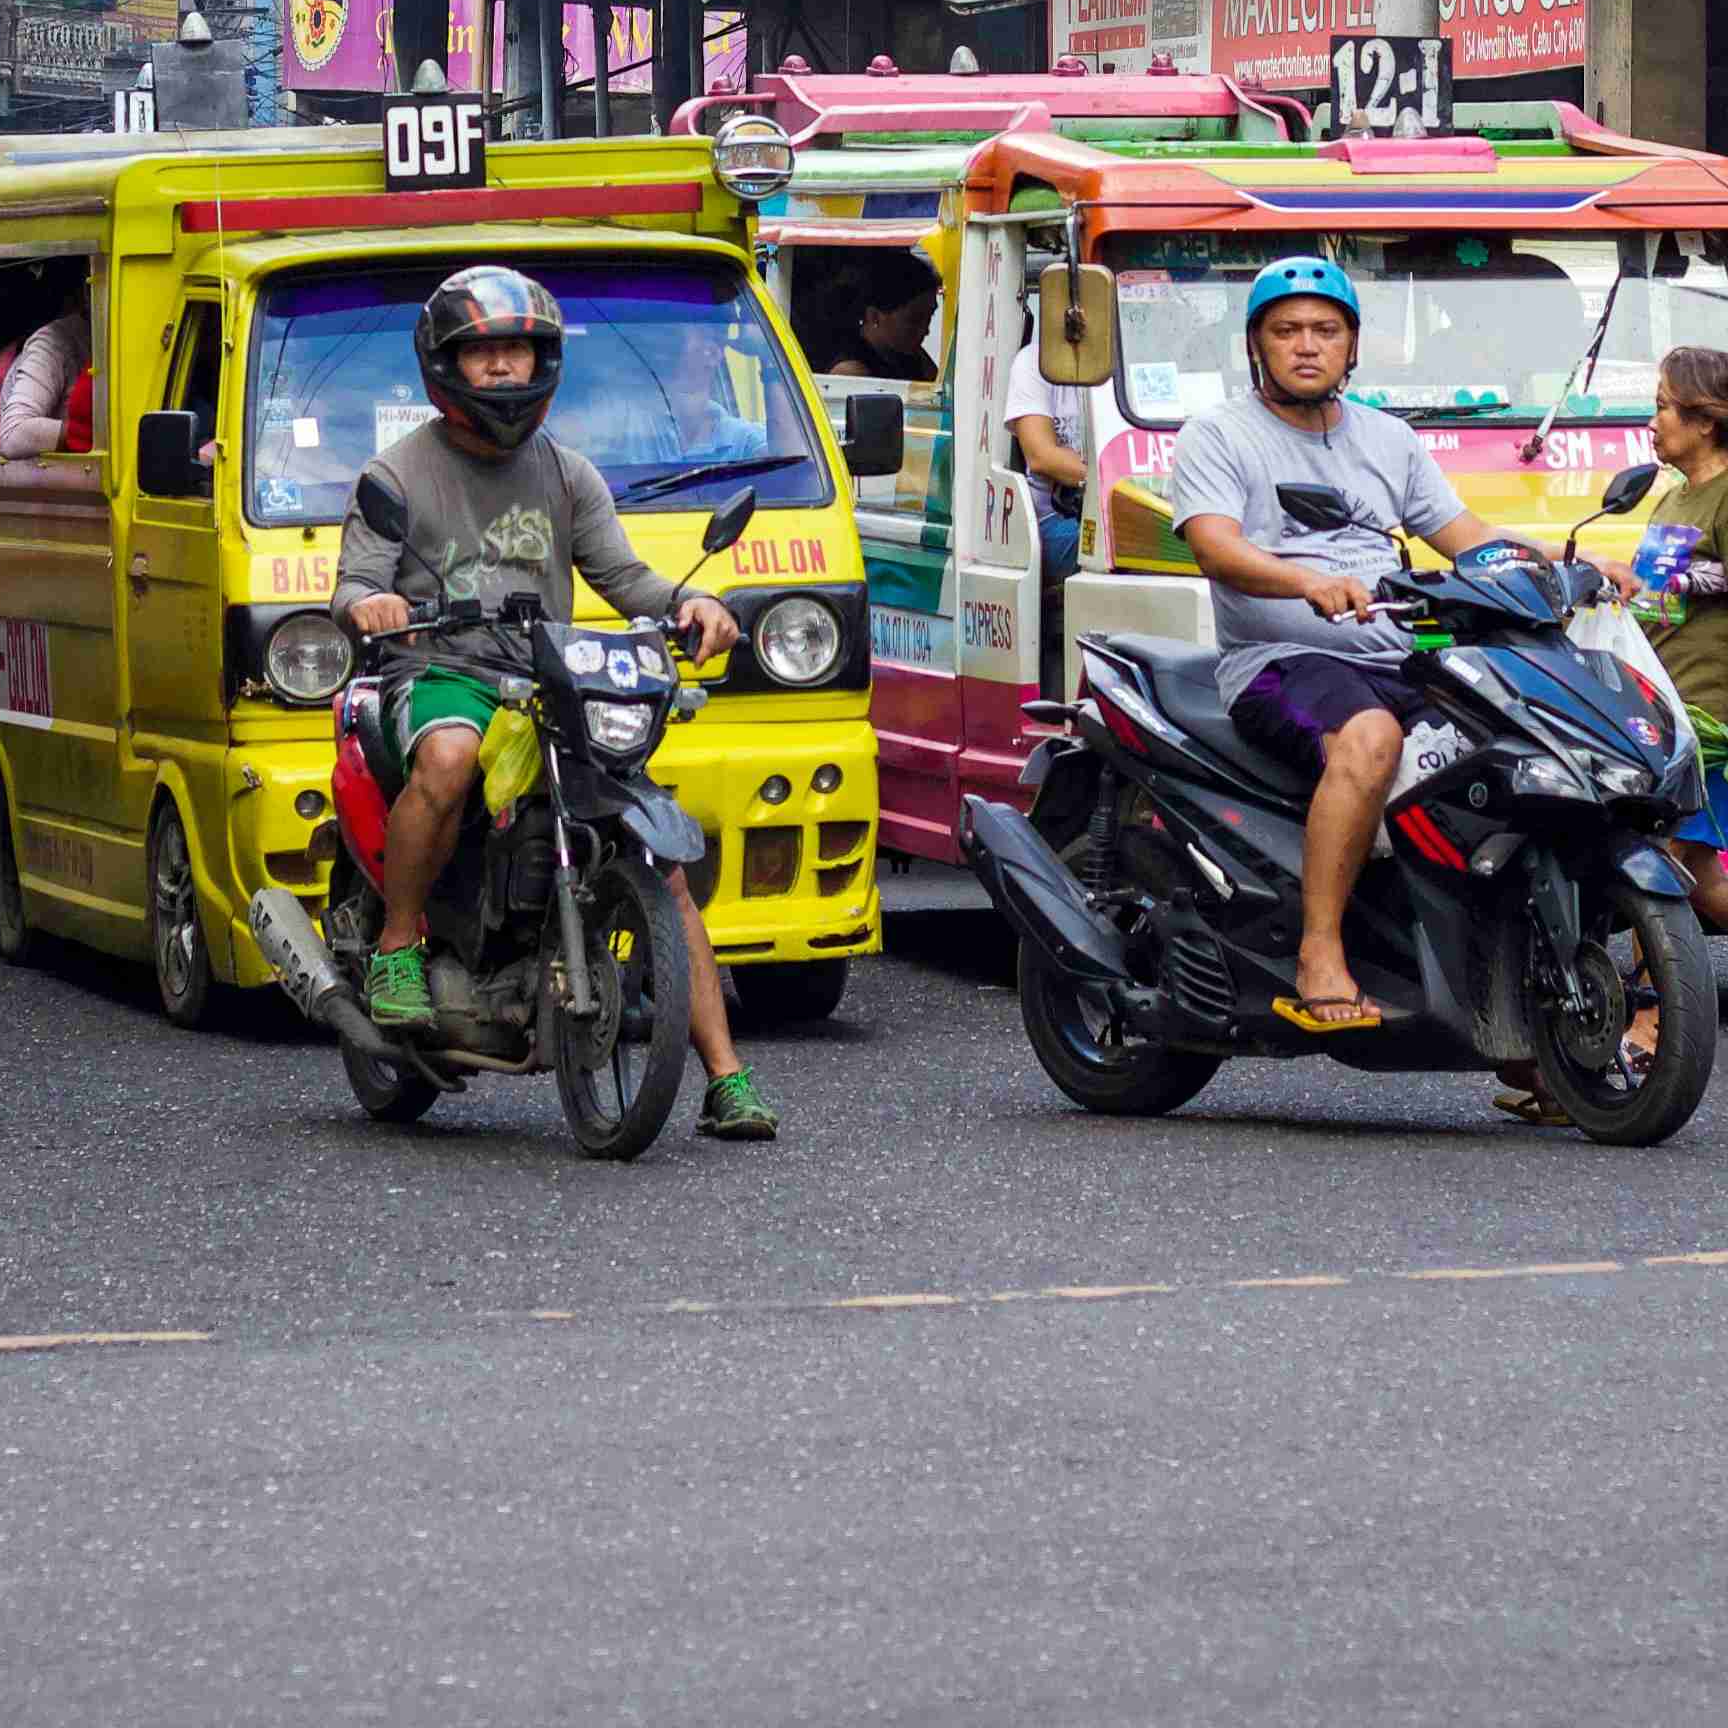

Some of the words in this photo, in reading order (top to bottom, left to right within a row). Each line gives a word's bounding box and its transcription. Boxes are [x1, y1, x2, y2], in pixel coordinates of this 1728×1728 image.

[387, 105, 482, 177] 09F
[1546, 430, 1593, 470] SM
[271, 556, 330, 594] BAS
[731, 539, 827, 576] COLON
[964, 597, 1014, 651] EXPRESS
